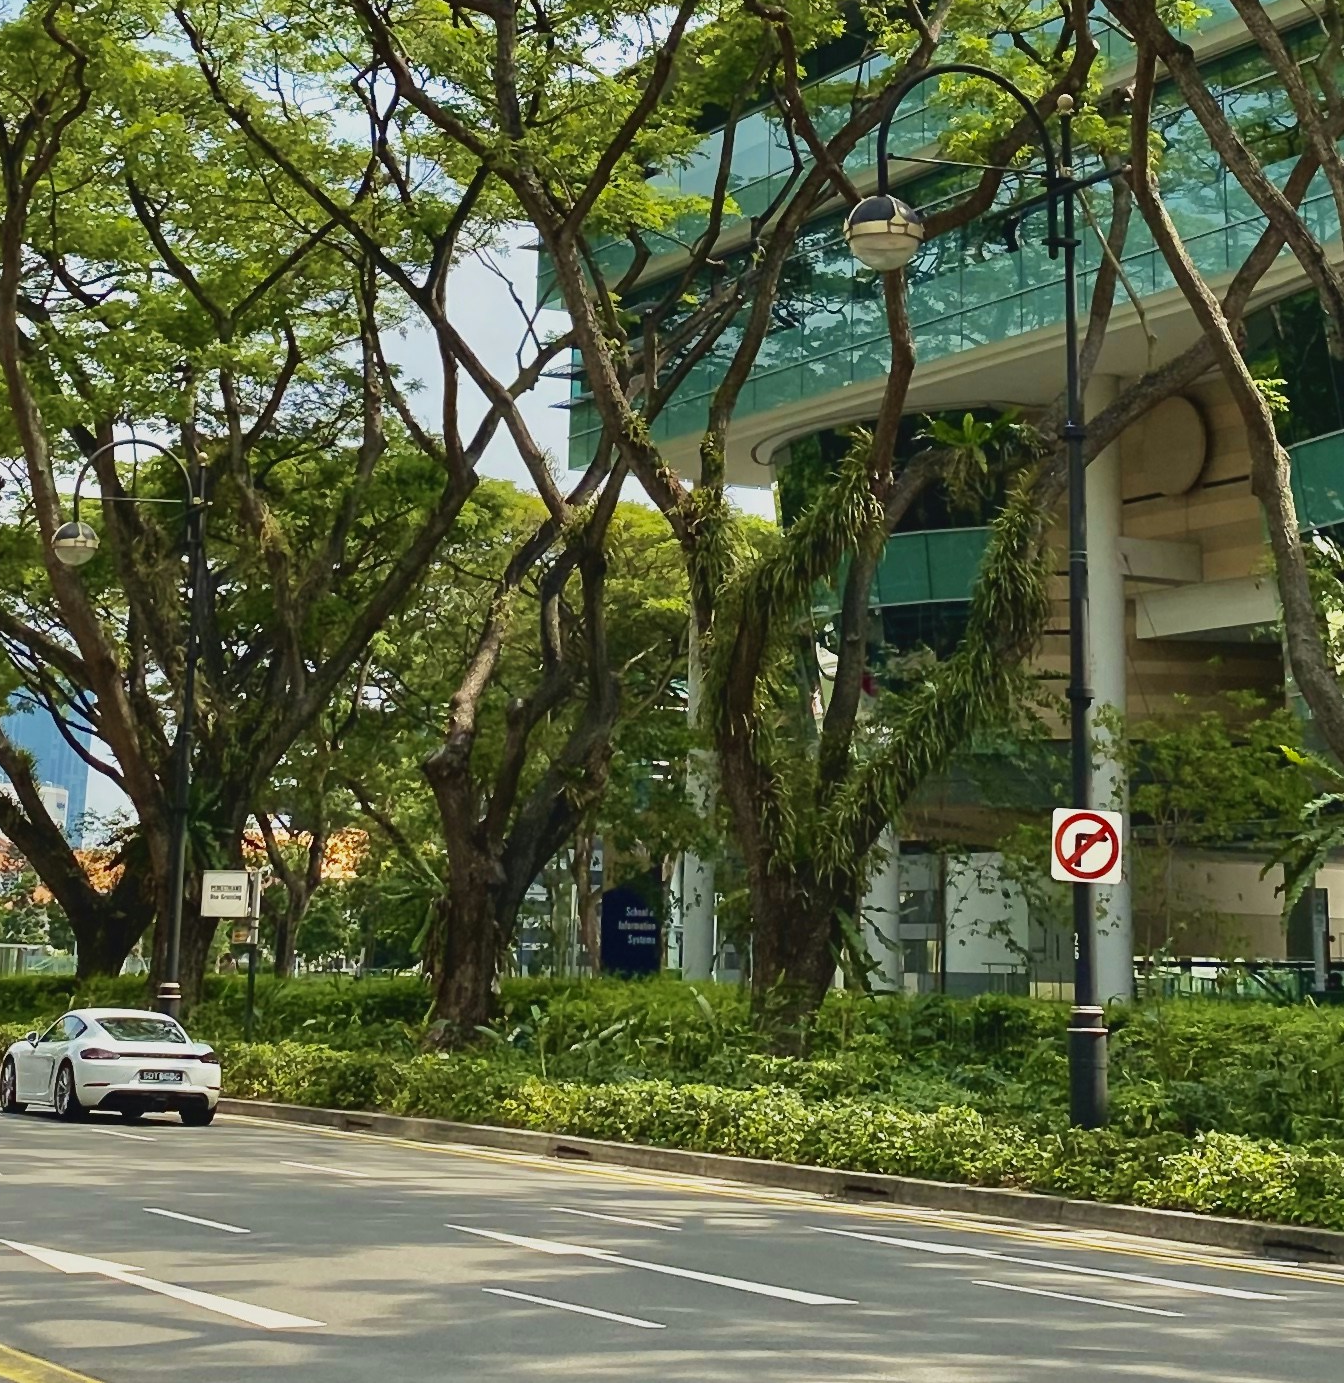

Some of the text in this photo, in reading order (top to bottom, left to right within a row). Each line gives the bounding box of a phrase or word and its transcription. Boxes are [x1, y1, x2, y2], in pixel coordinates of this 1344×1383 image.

[626, 906, 649, 917] School
[618, 920, 656, 931] Information
[627, 934, 656, 946] Systems
